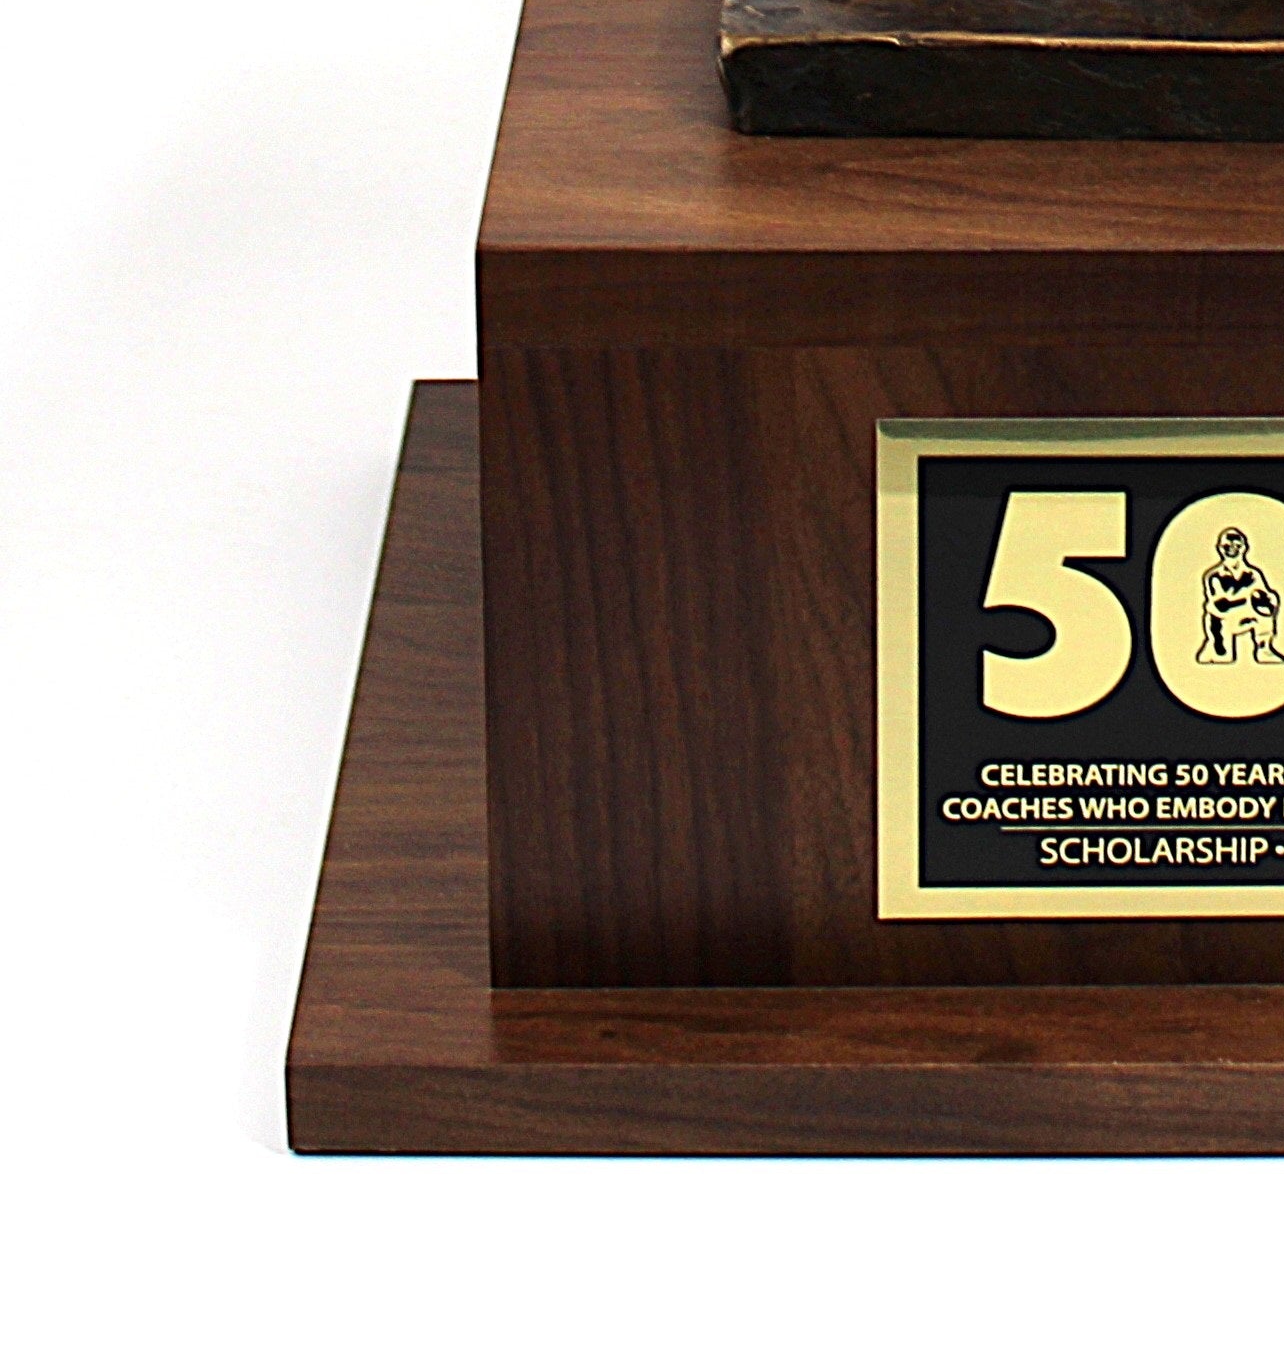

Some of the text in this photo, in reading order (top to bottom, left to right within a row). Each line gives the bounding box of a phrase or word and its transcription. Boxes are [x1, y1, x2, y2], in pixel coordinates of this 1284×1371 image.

[980, 763, 1169, 787] CELEBRATING
[1174, 764, 1209, 786] 50
[942, 797, 1074, 820] COACHES
[1078, 796, 1150, 820] WHO
[1156, 796, 1277, 819] EMBODY
[1039, 836, 1269, 865] SCHOLARSHIP
